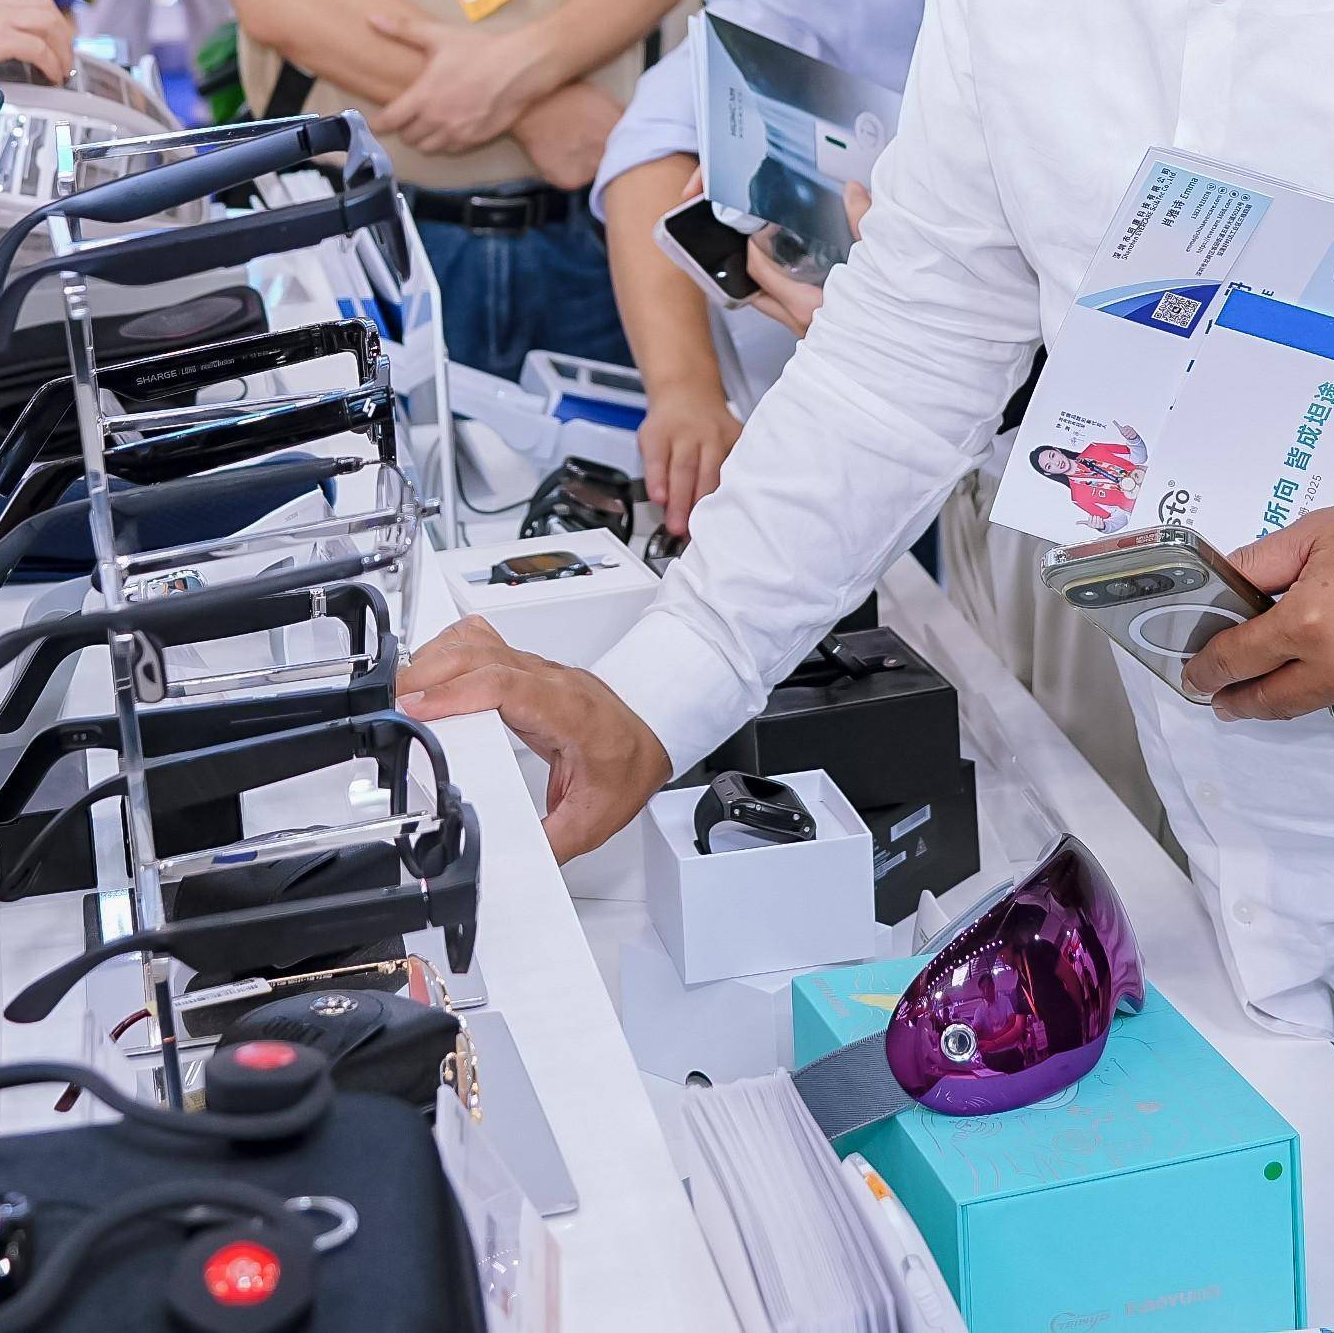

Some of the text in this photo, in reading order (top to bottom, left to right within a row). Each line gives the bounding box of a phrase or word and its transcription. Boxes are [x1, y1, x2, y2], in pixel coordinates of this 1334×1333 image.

[1162, 177, 1198, 227] 肖雅诗 Emma
[1121, 237, 1139, 260] Shenzhen
[1137, 212, 1153, 237] EVERCARE
[135, 369, 178, 386] SHARGE
